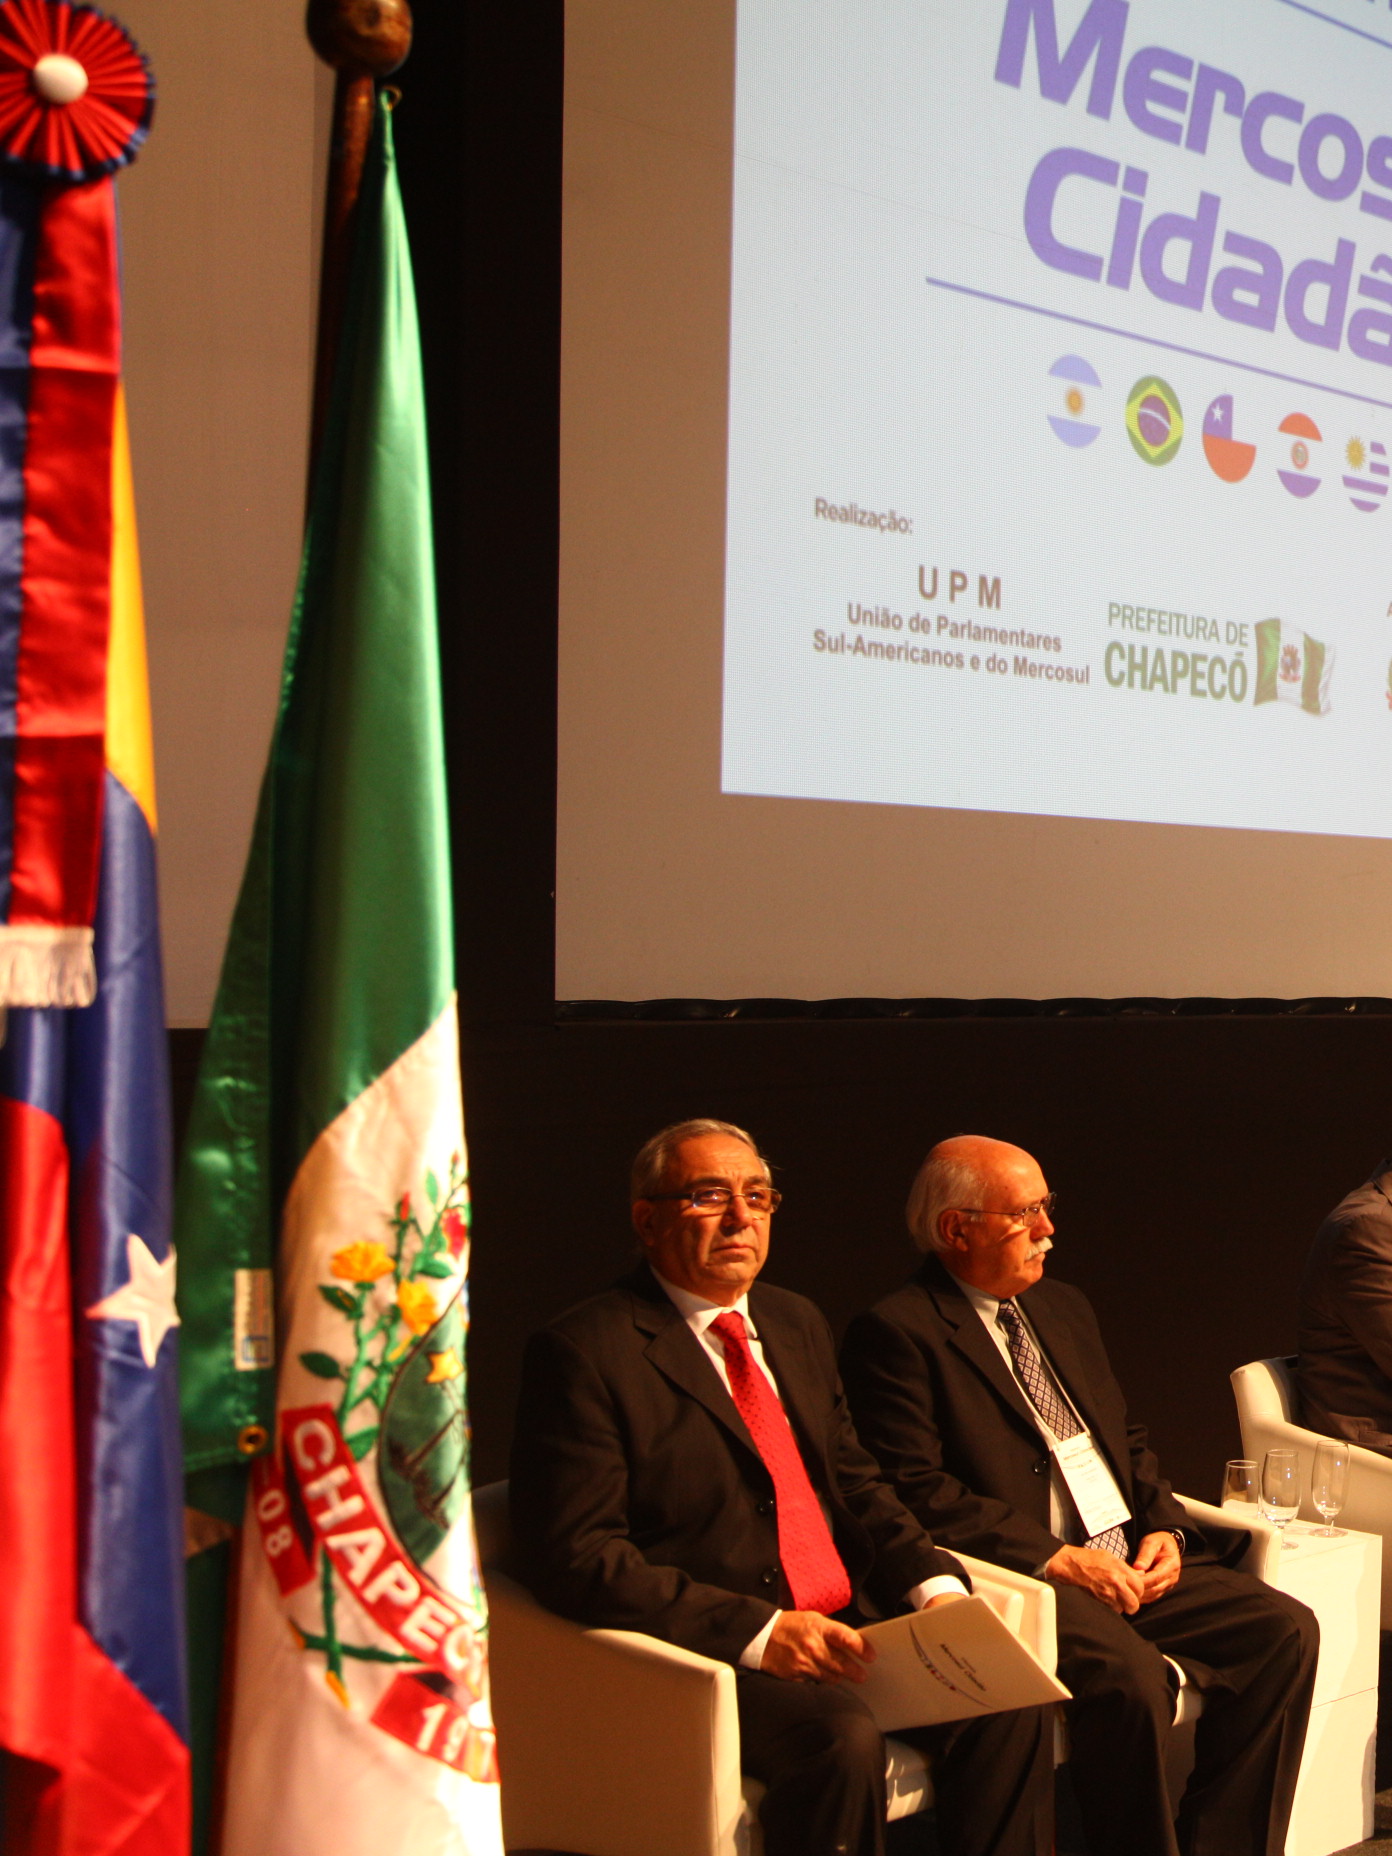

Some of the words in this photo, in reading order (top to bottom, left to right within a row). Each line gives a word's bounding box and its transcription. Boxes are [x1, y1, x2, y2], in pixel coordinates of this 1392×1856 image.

[814, 497, 914, 535] Realização:
[847, 602, 904, 630] União
[908, 612, 931, 634] de
[936, 614, 1062, 653] Parlamentares
[1108, 602, 1220, 643] PREFEITURA
[1225, 620, 1249, 647] DE
[813, 628, 965, 670] Sul-Americanos
[970, 654, 981, 672] e
[986, 652, 1008, 676] do
[1013, 655, 1090, 685] Mercosul
[1104, 640, 1248, 703] CHAPECÓ
